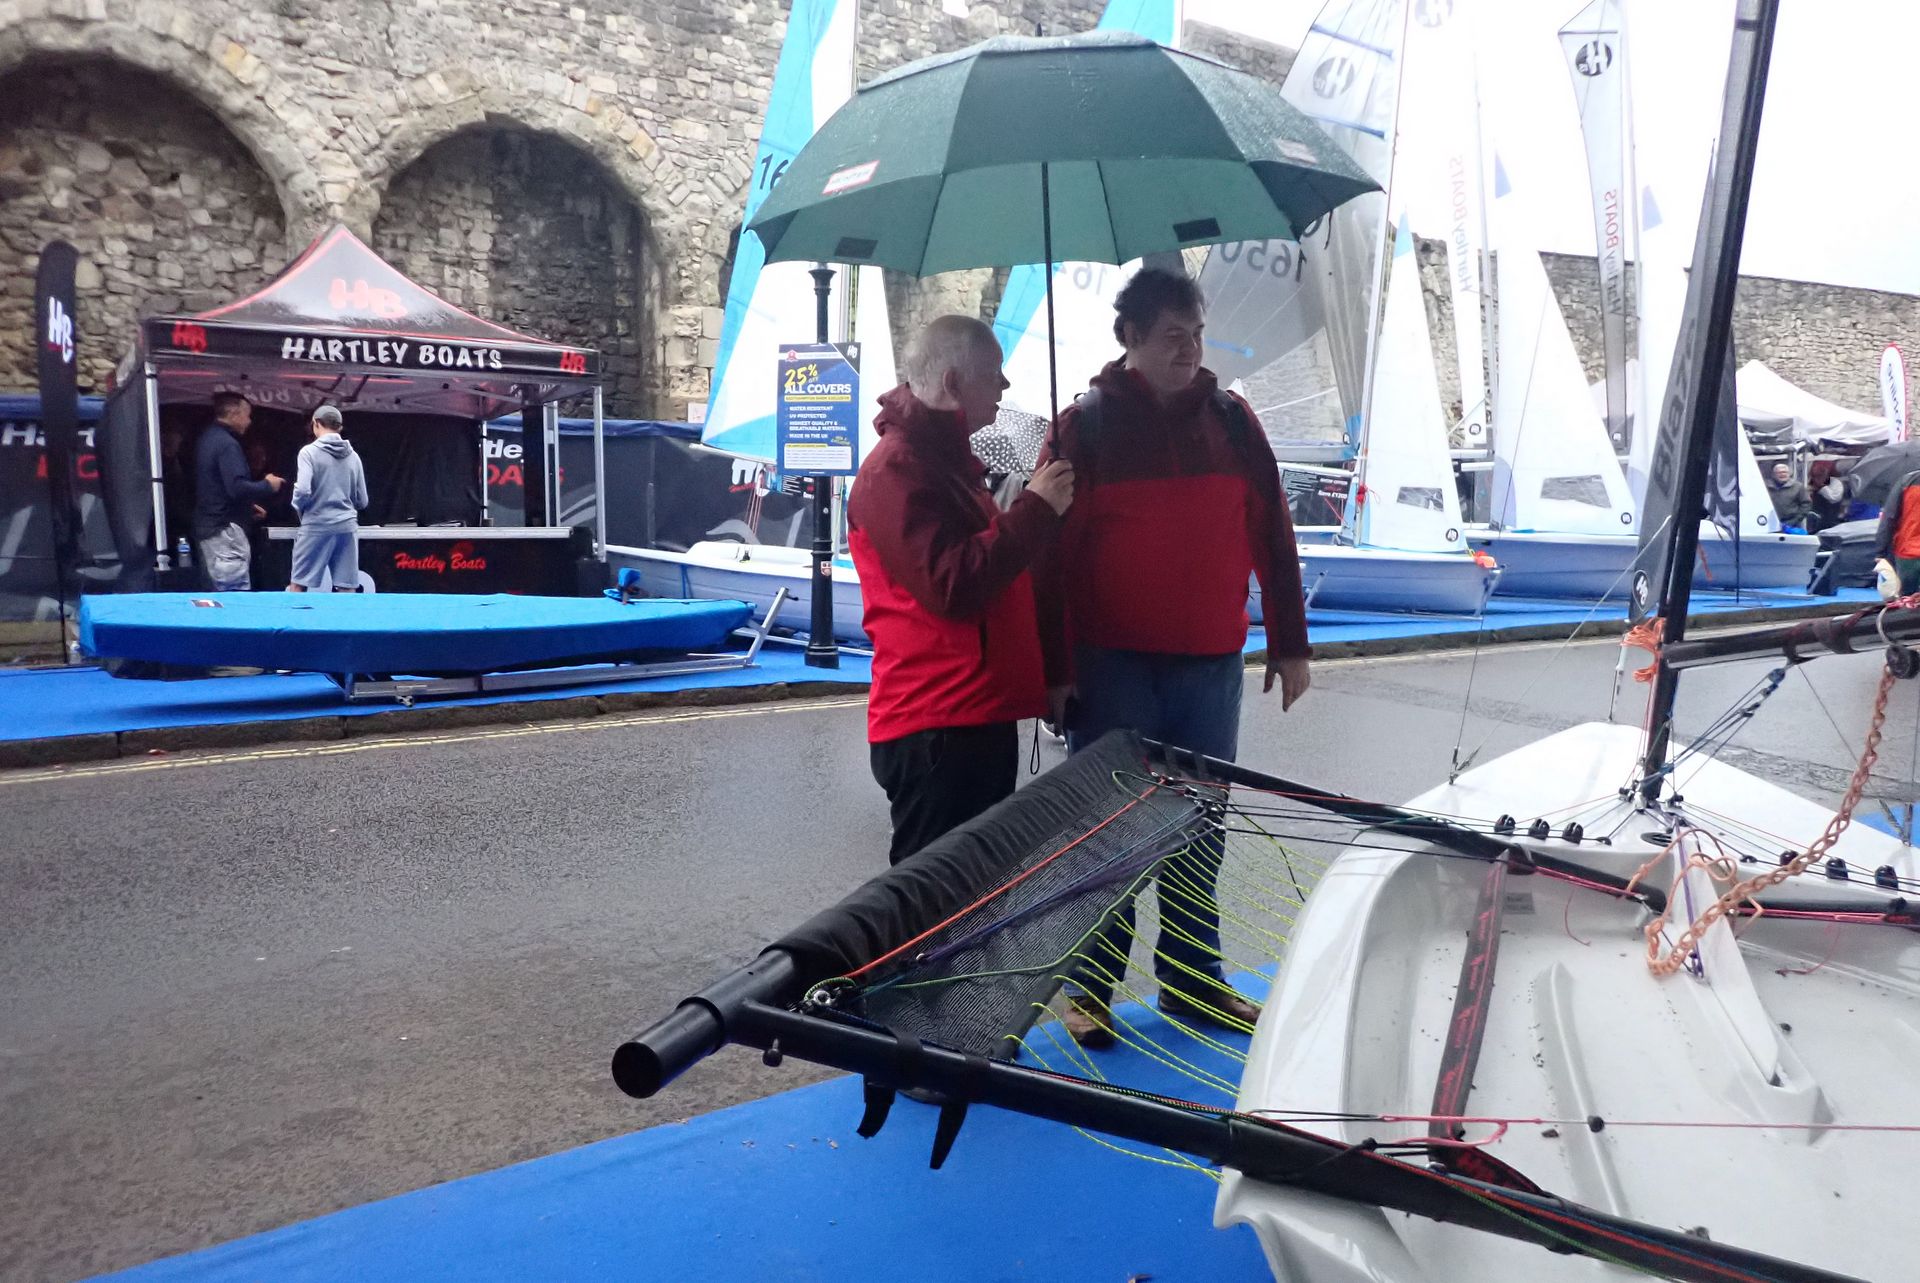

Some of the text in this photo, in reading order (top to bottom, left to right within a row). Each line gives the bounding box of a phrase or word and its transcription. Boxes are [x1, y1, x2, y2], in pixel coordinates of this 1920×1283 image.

[328, 278, 408, 319] HB
[171, 320, 208, 354] HB
[281, 337, 502, 369] HARTLEY BOATS
[784, 363, 818, 387] 25%
[784, 383, 852, 395] ALL COVERS
[394, 552, 487, 574] Hartley Boats
